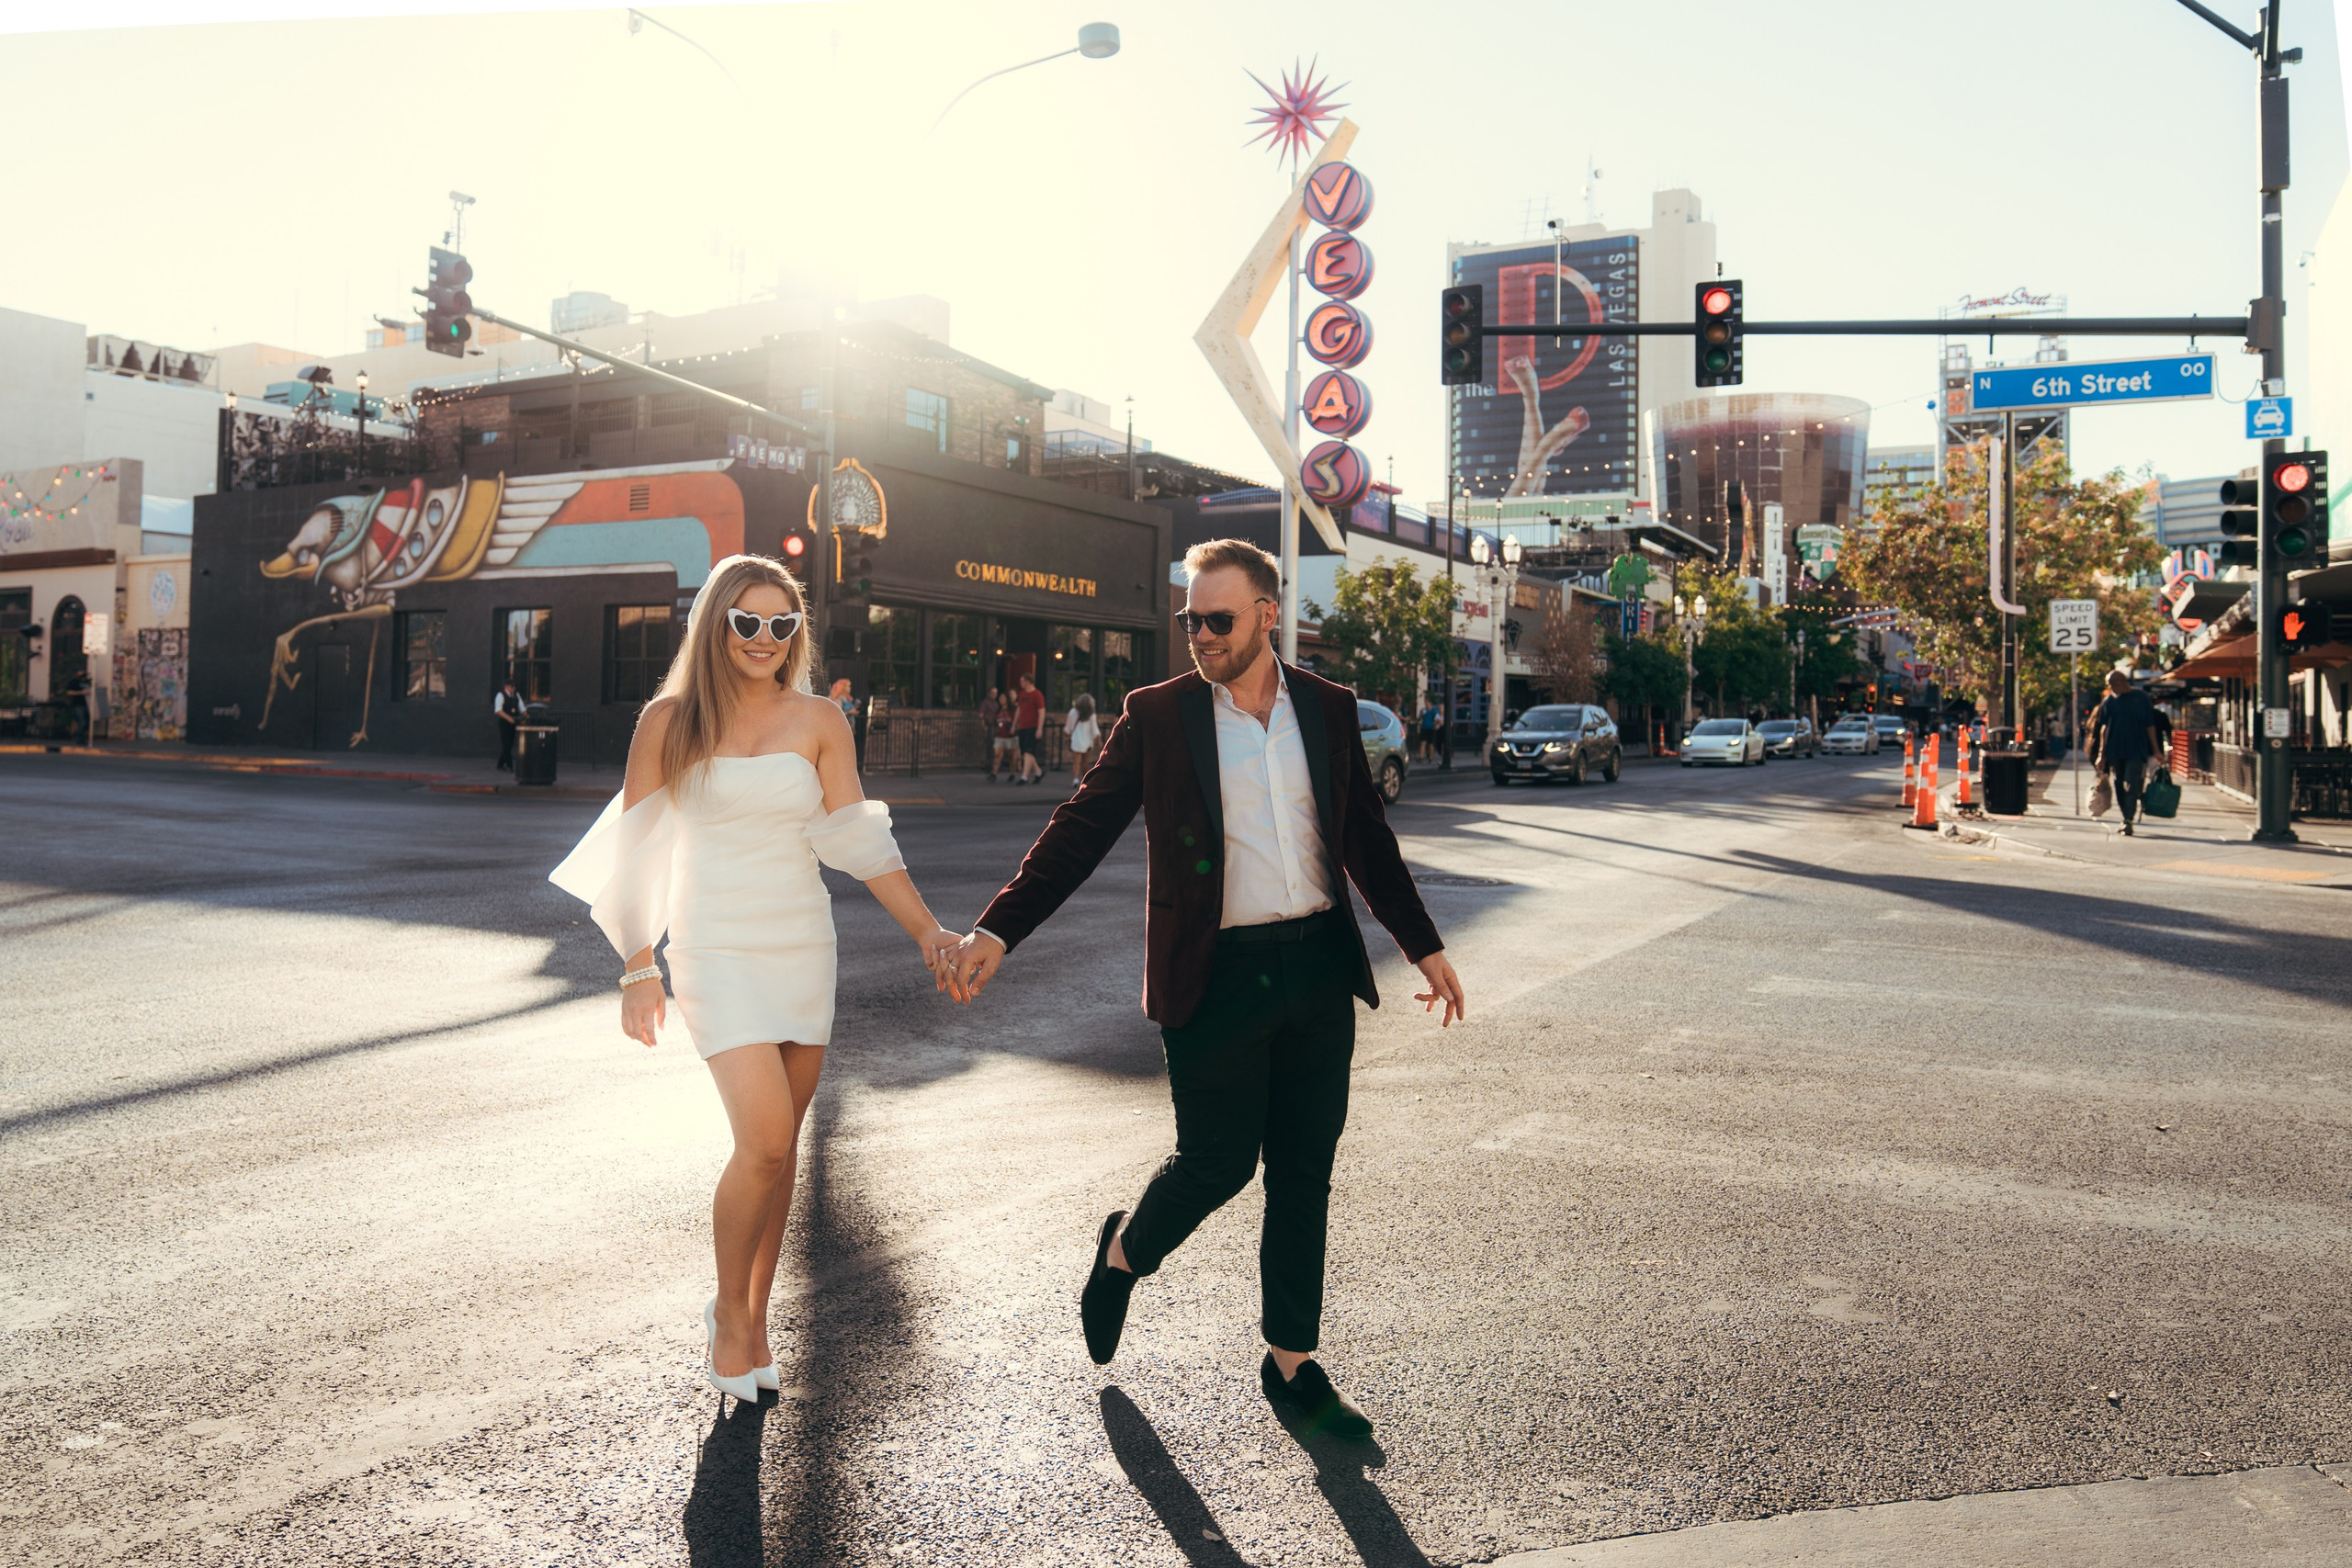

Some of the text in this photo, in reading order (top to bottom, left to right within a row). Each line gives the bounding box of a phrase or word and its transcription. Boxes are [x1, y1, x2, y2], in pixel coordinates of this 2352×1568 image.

[1306, 166, 1361, 498] VEGAS
[1498, 263, 1603, 394] D
[1609, 344, 1626, 387] LAS
[1980, 378, 1991, 389] N
[2031, 378, 2071, 397] 6th
[2080, 370, 2152, 394] Street
[739, 443, 804, 468] FREMONT
[955, 559, 1097, 597] COMMONWEALTH
[2054, 604, 2093, 613] SPEED
[2058, 615, 2088, 626] LIMIT
[2056, 628, 2092, 647] 25
